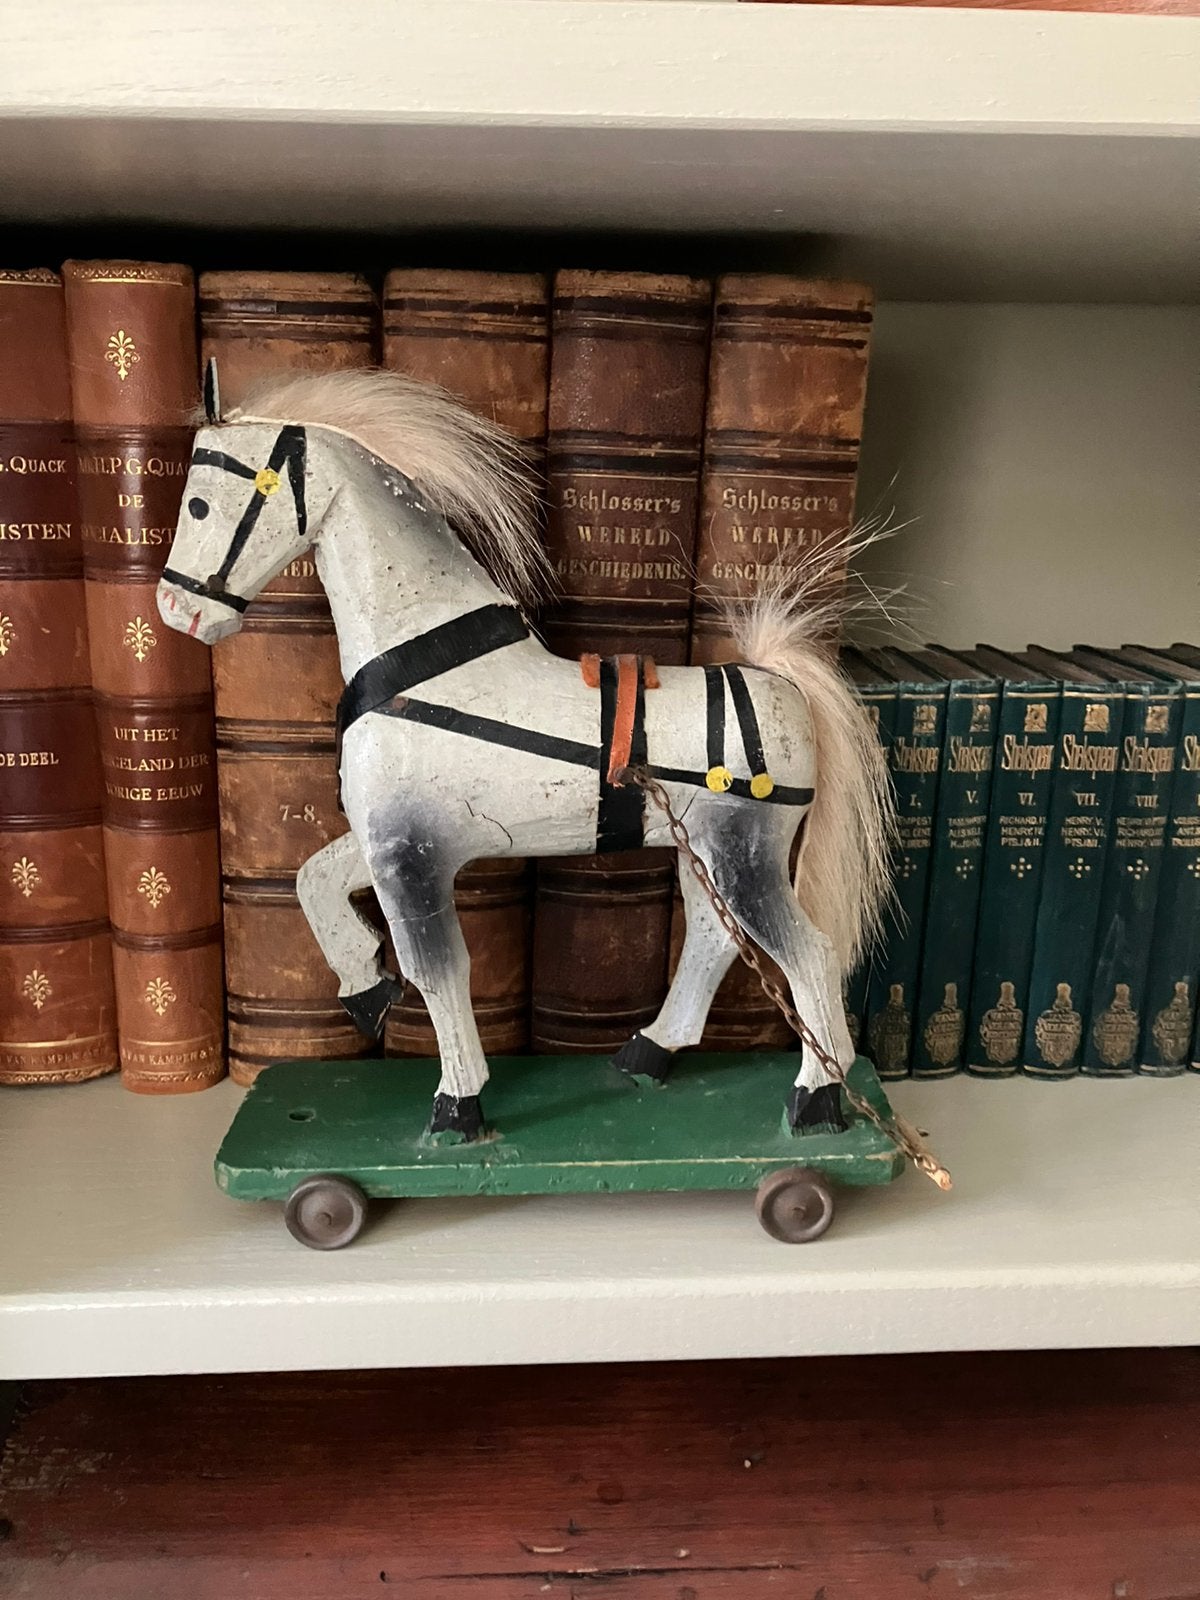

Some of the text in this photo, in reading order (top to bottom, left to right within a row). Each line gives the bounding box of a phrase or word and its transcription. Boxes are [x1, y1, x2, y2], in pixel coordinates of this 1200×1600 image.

[0, 456, 66, 474] .QUACK
[118, 494, 144, 507] DE
[722, 487, 838, 515] Schlosser's
[577, 525, 671, 545] WERELD
[114, 727, 180, 742] UIT HET
[20, 752, 60, 767] DEEL
[178, 753, 209, 769] DER
[156, 783, 203, 801] EEUW
[966, 790, 979, 804] V.
[1018, 792, 1036, 806] VI.
[1075, 793, 1100, 806] VII.
[1136, 795, 1159, 808] VIII.
[279, 803, 322, 825] 7-8.
